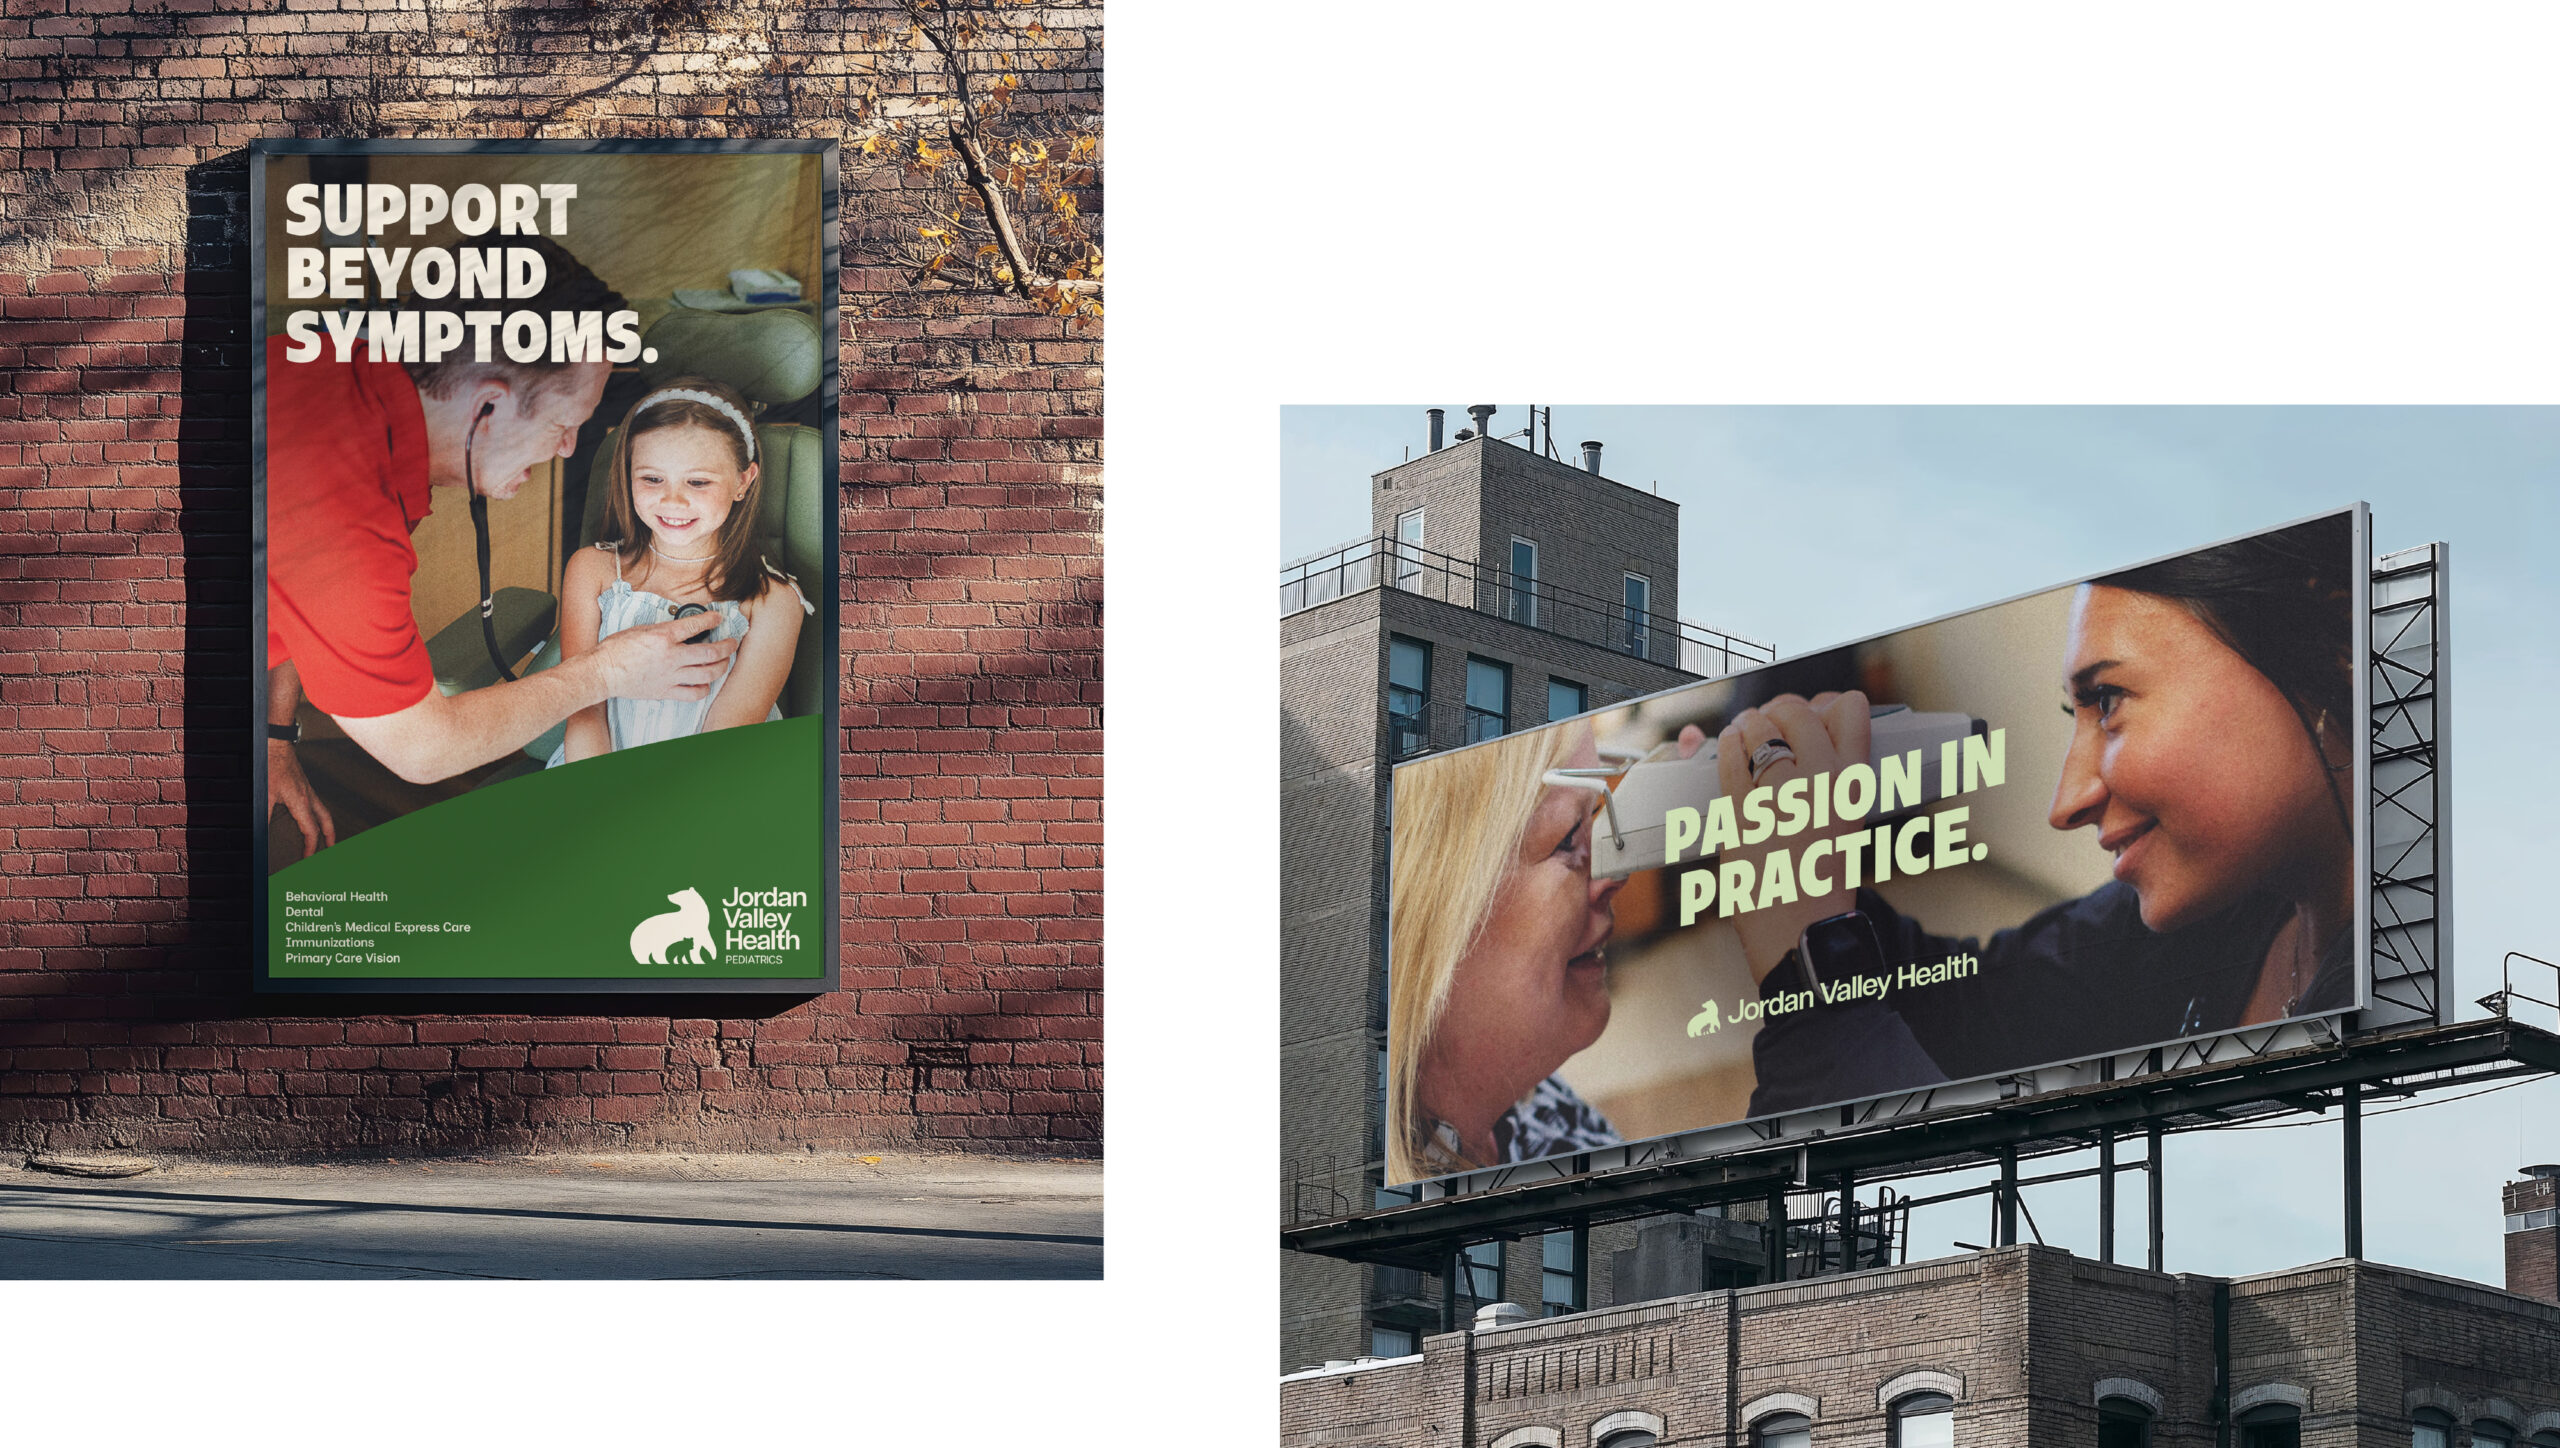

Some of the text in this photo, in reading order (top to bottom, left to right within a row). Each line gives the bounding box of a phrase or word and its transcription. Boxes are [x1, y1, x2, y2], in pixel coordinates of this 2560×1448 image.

[286, 183, 578, 236] SUPPORT
[287, 246, 547, 300] BEYOND
[286, 309, 659, 364] SYMPTOMS.
[1665, 728, 2006, 865] PASSION IN
[1680, 806, 1989, 928] PRACTICE.
[285, 891, 388, 902] Behavioral Health
[722, 886, 807, 907] Jordan
[285, 906, 324, 917] Dental
[722, 908, 792, 933] Valley
[345, 921, 391, 933] Medical
[394, 921, 440, 935] Express
[442, 921, 471, 933] Care
[285, 937, 375, 948] Immunizations
[725, 929, 801, 950] Health
[285, 952, 401, 966] Primary Care Vision
[725, 955, 783, 965] PEDIATRICS
[1727, 952, 1979, 1024] Jordan Valley Health
